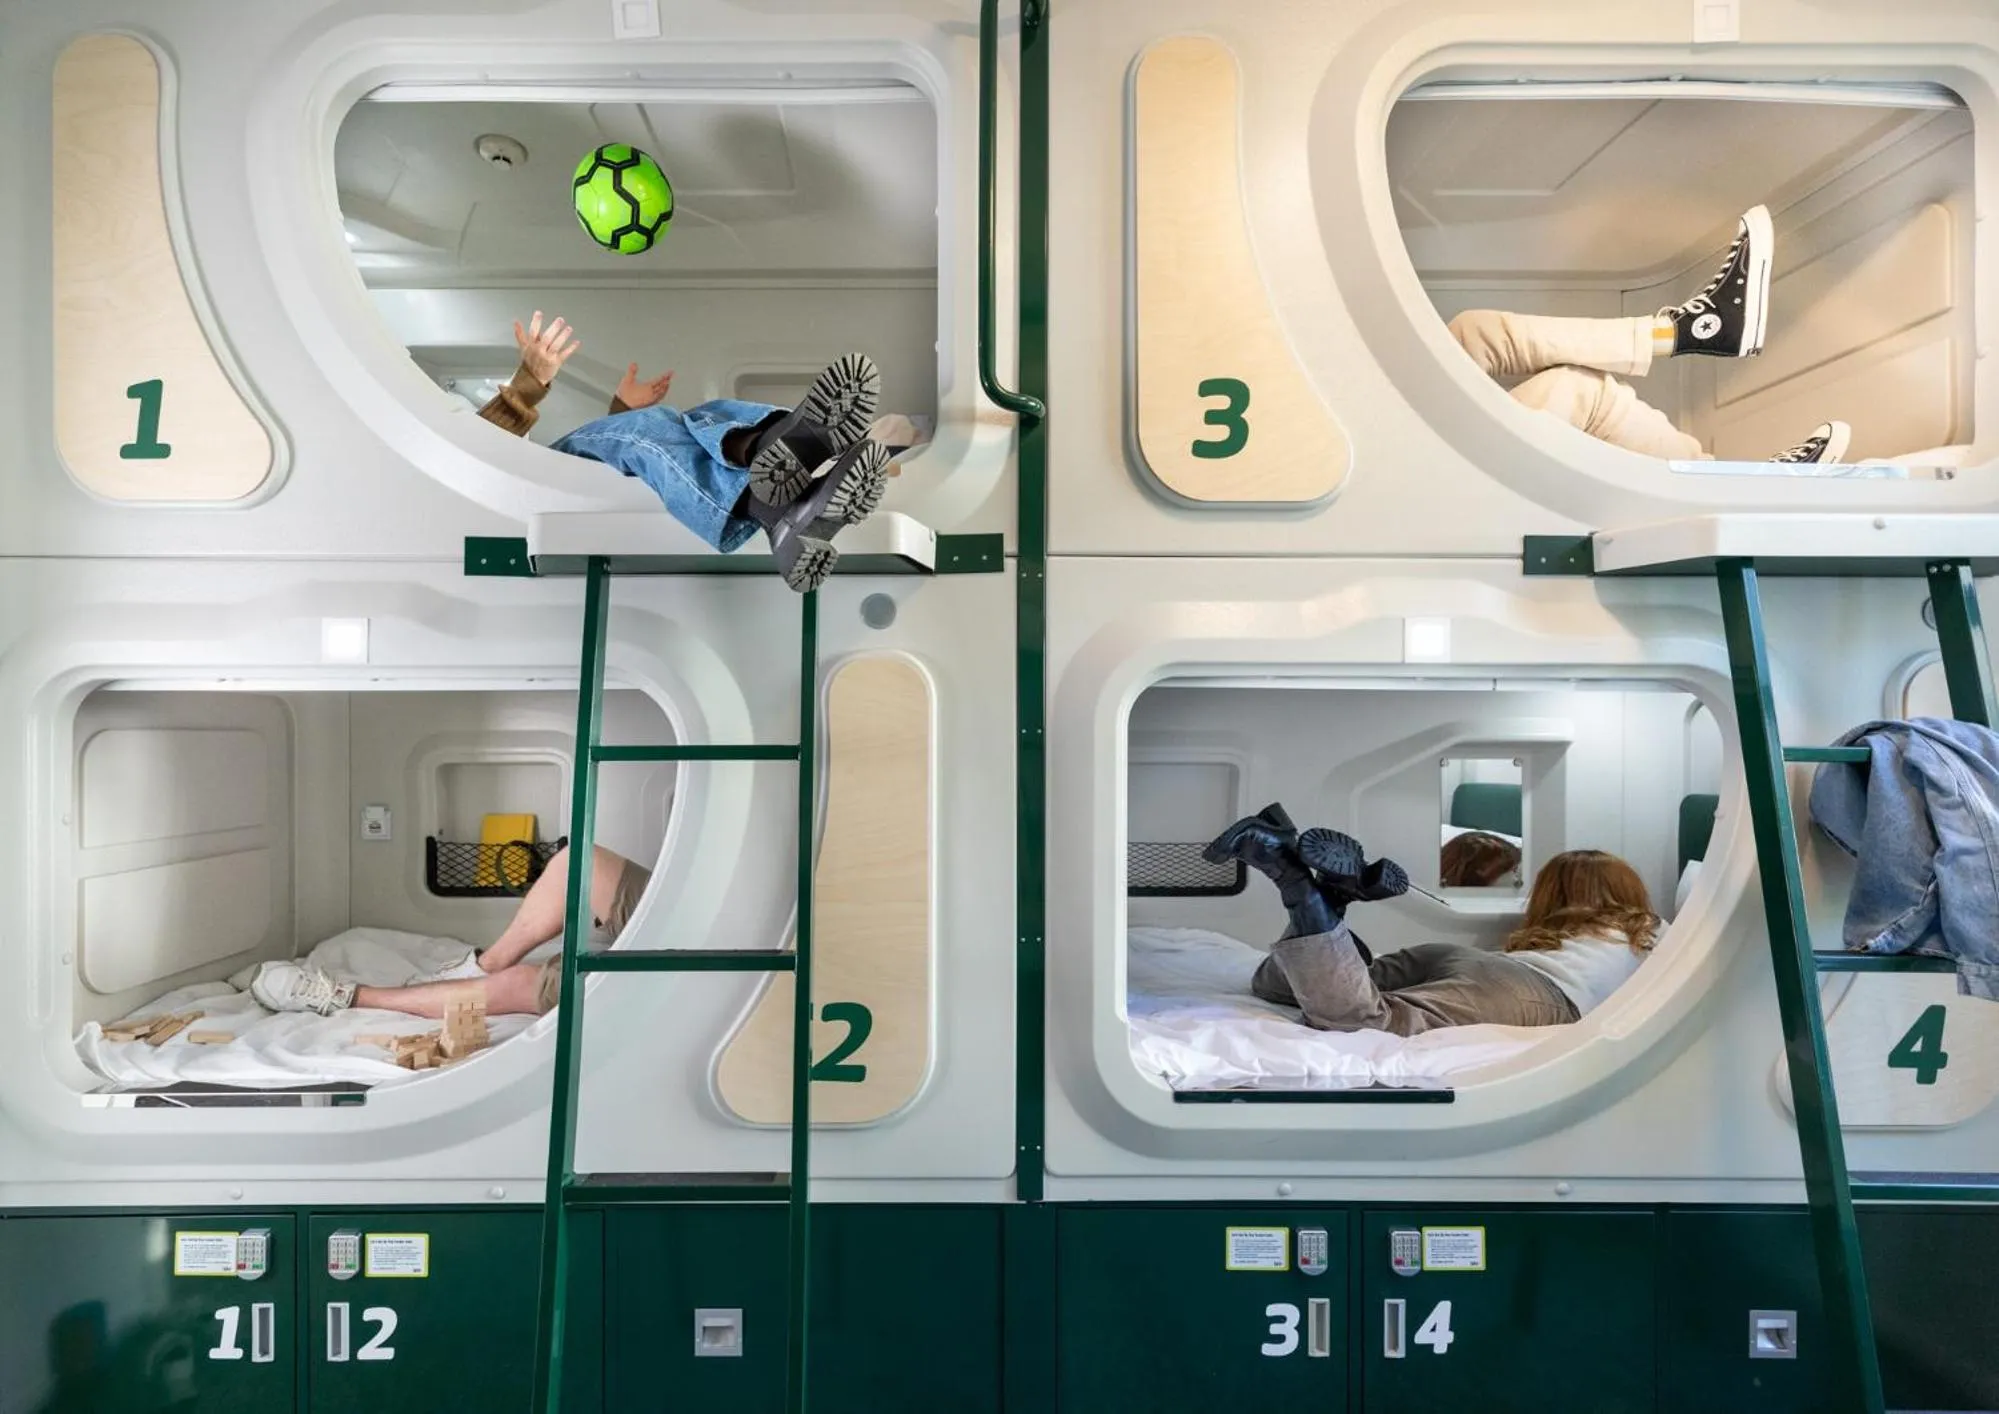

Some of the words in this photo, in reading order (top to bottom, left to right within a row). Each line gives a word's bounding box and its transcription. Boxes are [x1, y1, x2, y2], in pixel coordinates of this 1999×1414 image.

[120, 380, 170, 458] 1
[1193, 379, 1249, 458] 3
[811, 1002, 872, 1083] 2
[1888, 1005, 1948, 1085] 4
[209, 1306, 243, 1359] 1
[357, 1307, 398, 1360] 2
[1261, 1303, 1300, 1356] 3
[1414, 1300, 1454, 1354] 4
